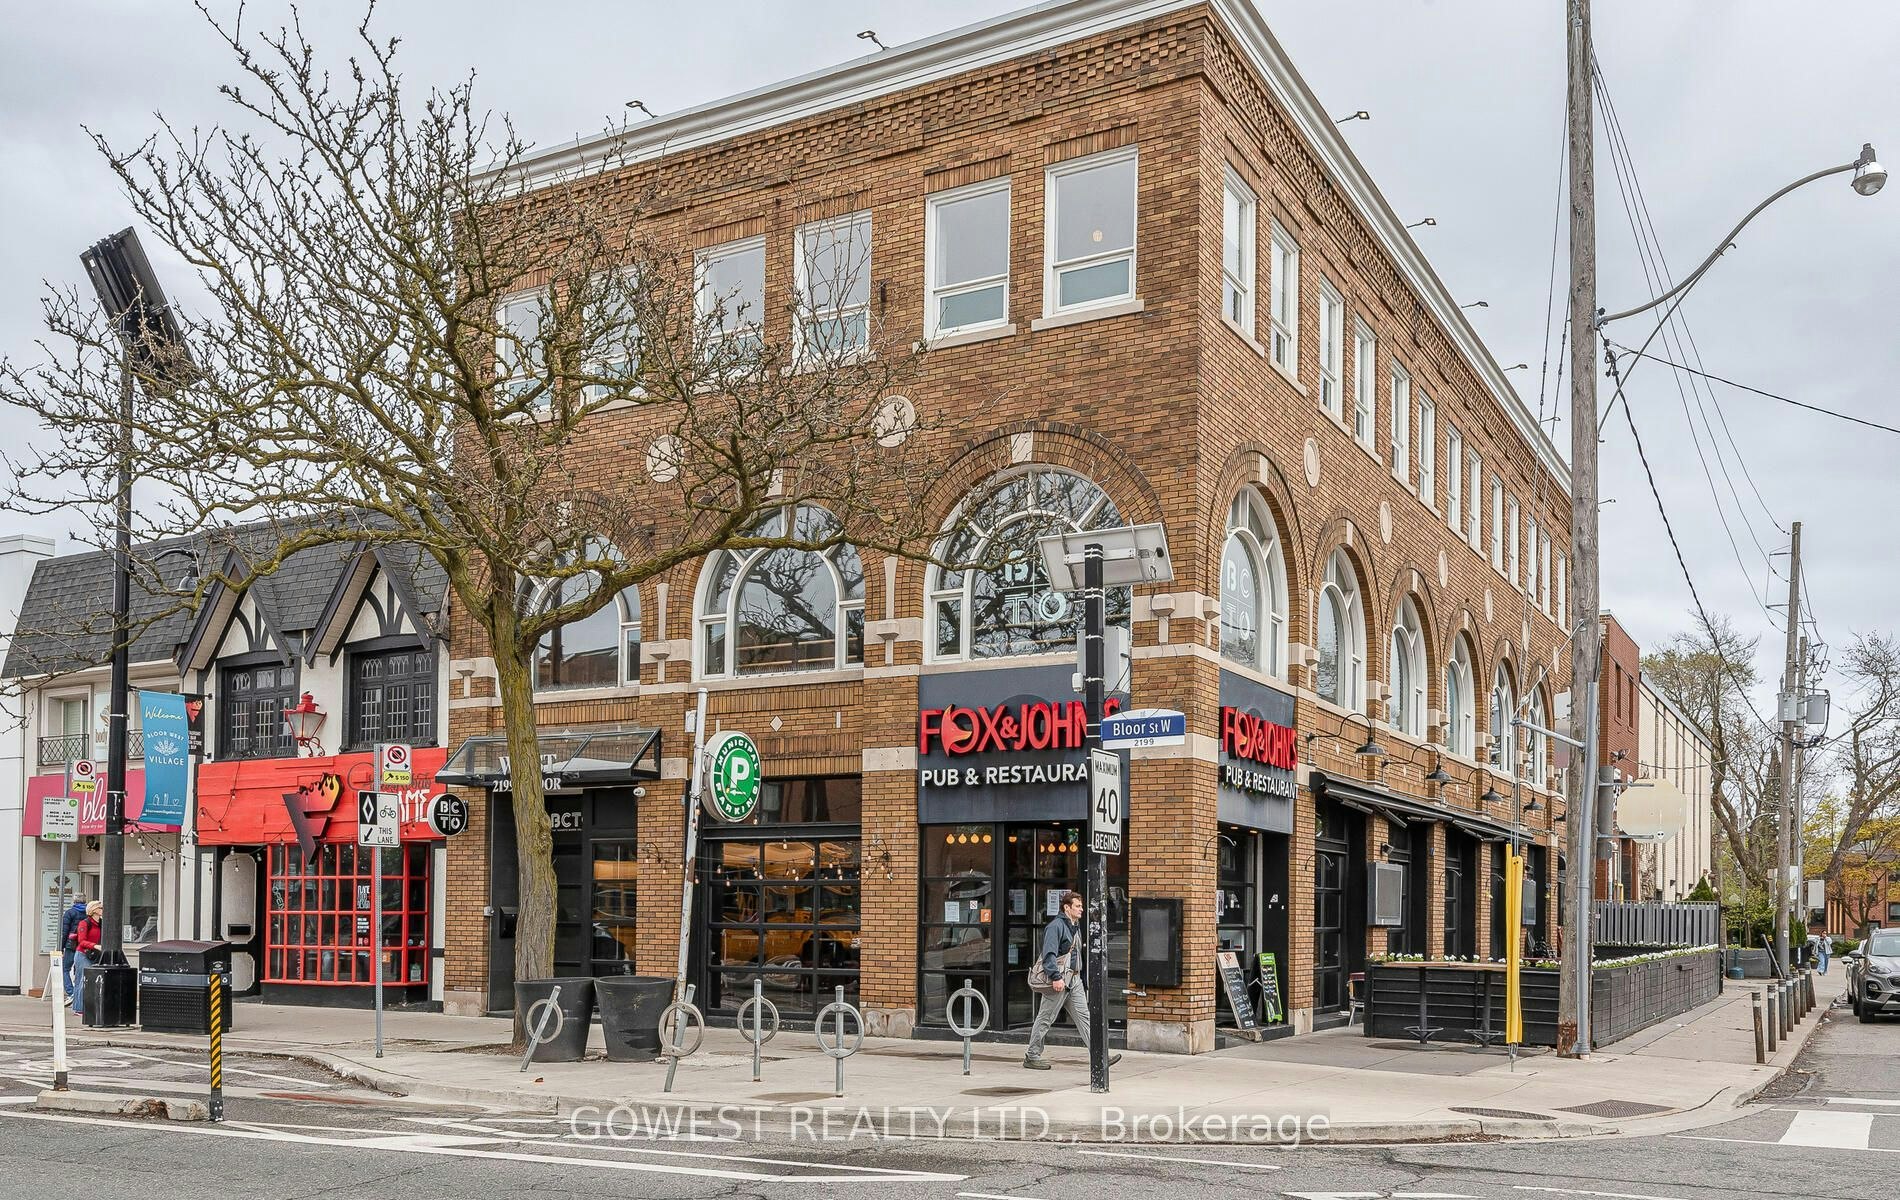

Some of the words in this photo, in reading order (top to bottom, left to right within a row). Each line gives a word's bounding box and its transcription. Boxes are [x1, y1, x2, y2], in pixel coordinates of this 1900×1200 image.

[145, 706, 184, 720] Welcome
[147, 730, 167, 739] BLOOR
[170, 732, 184, 740] WEST
[1113, 721, 1146, 736] Bloor
[1150, 723, 1159, 734] St
[1160, 719, 1171, 733] W
[1134, 738, 1154, 746] 2199
[149, 755, 184, 766] VILLAGE
[718, 739, 759, 770] MUNICIPAL
[730, 756, 750, 788] P
[921, 768, 959, 787] PUB
[965, 767, 979, 785] &
[986, 763, 1087, 785] RESTAURA
[1094, 761, 1118, 777] MAXIMUM
[1226, 764, 1243, 786] PUB
[1245, 770, 1252, 787] &
[1253, 772, 1299, 799] RESTAURANT
[716, 782, 759, 815] PARKING
[1096, 788, 1119, 825] 40
[551, 812, 584, 828] BCT
[379, 827, 392, 835] THIS
[377, 836, 393, 844] LANE
[1095, 834, 1119, 851] BEGINS
